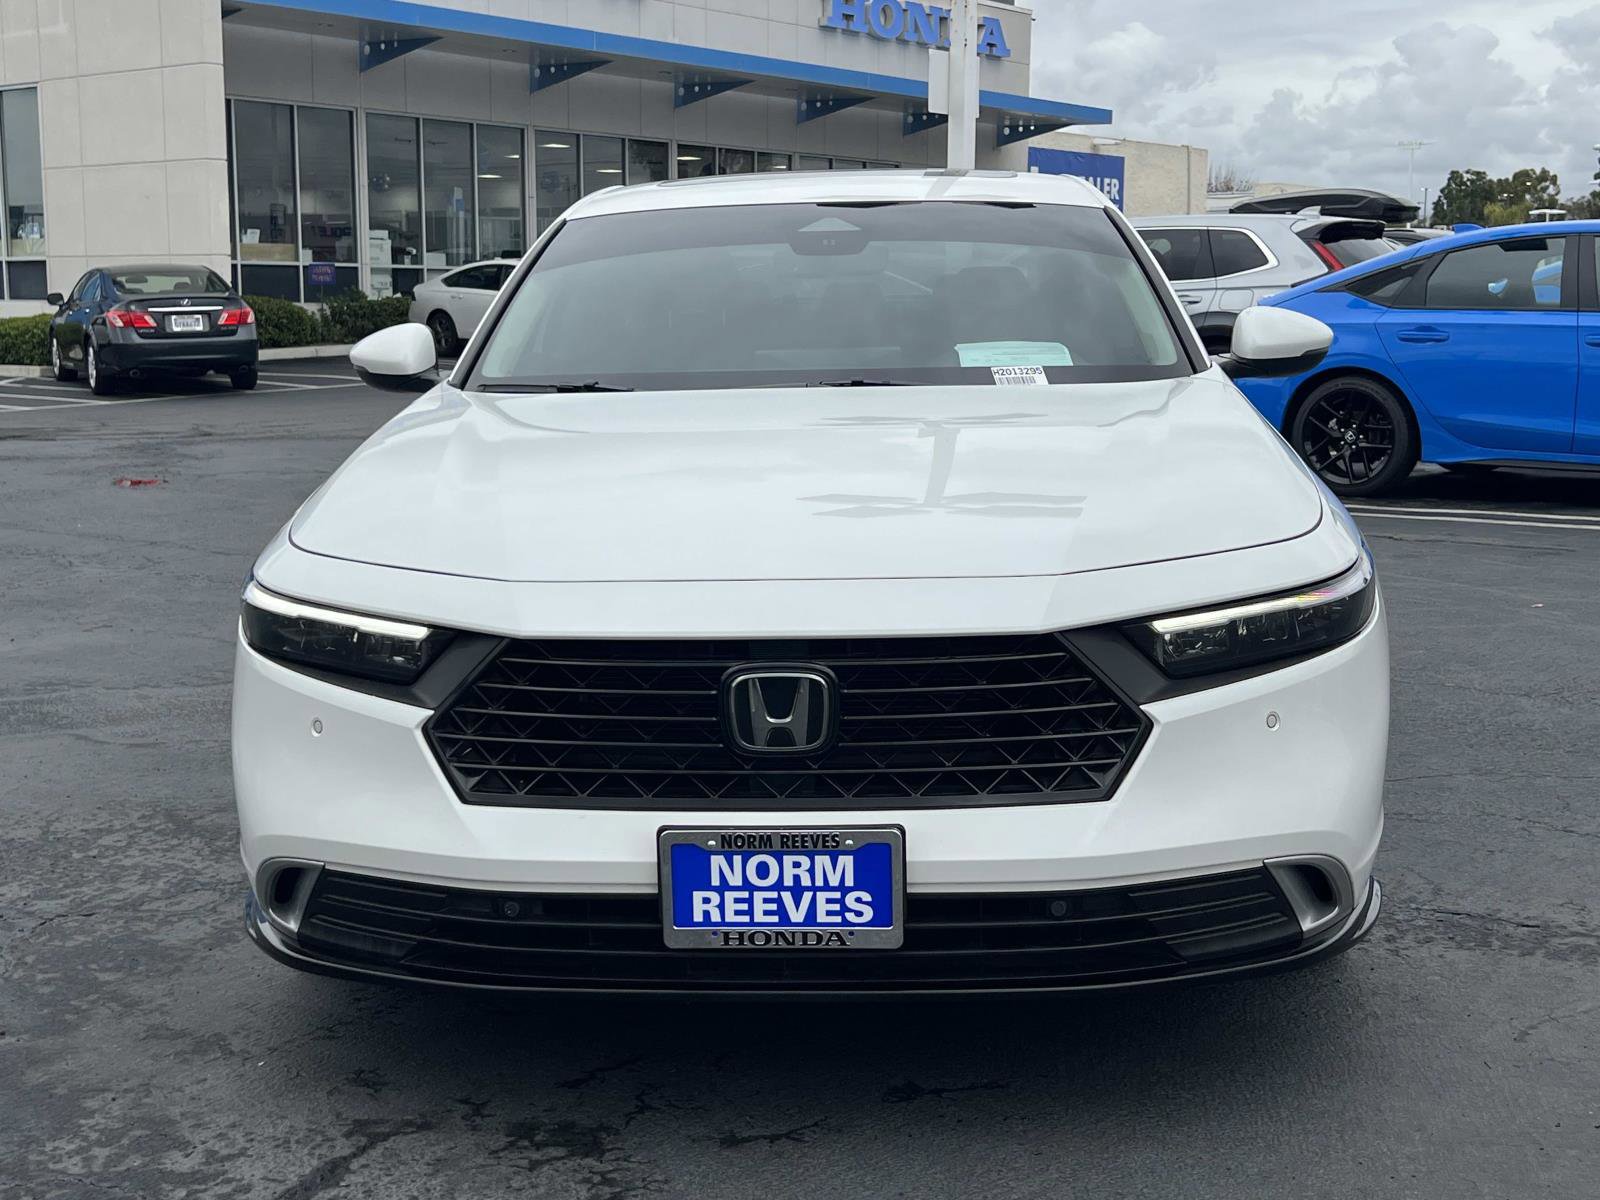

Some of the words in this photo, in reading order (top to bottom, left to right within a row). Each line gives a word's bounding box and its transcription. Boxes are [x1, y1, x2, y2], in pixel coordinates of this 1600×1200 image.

[825, 0, 1011, 58] HONA
[993, 367, 1043, 376] H2013295
[720, 832, 773, 849] NORM
[780, 832, 840, 849] REEVES
[710, 854, 854, 887] NORM
[692, 890, 874, 924] REEVES
[720, 930, 850, 947] HONDA
